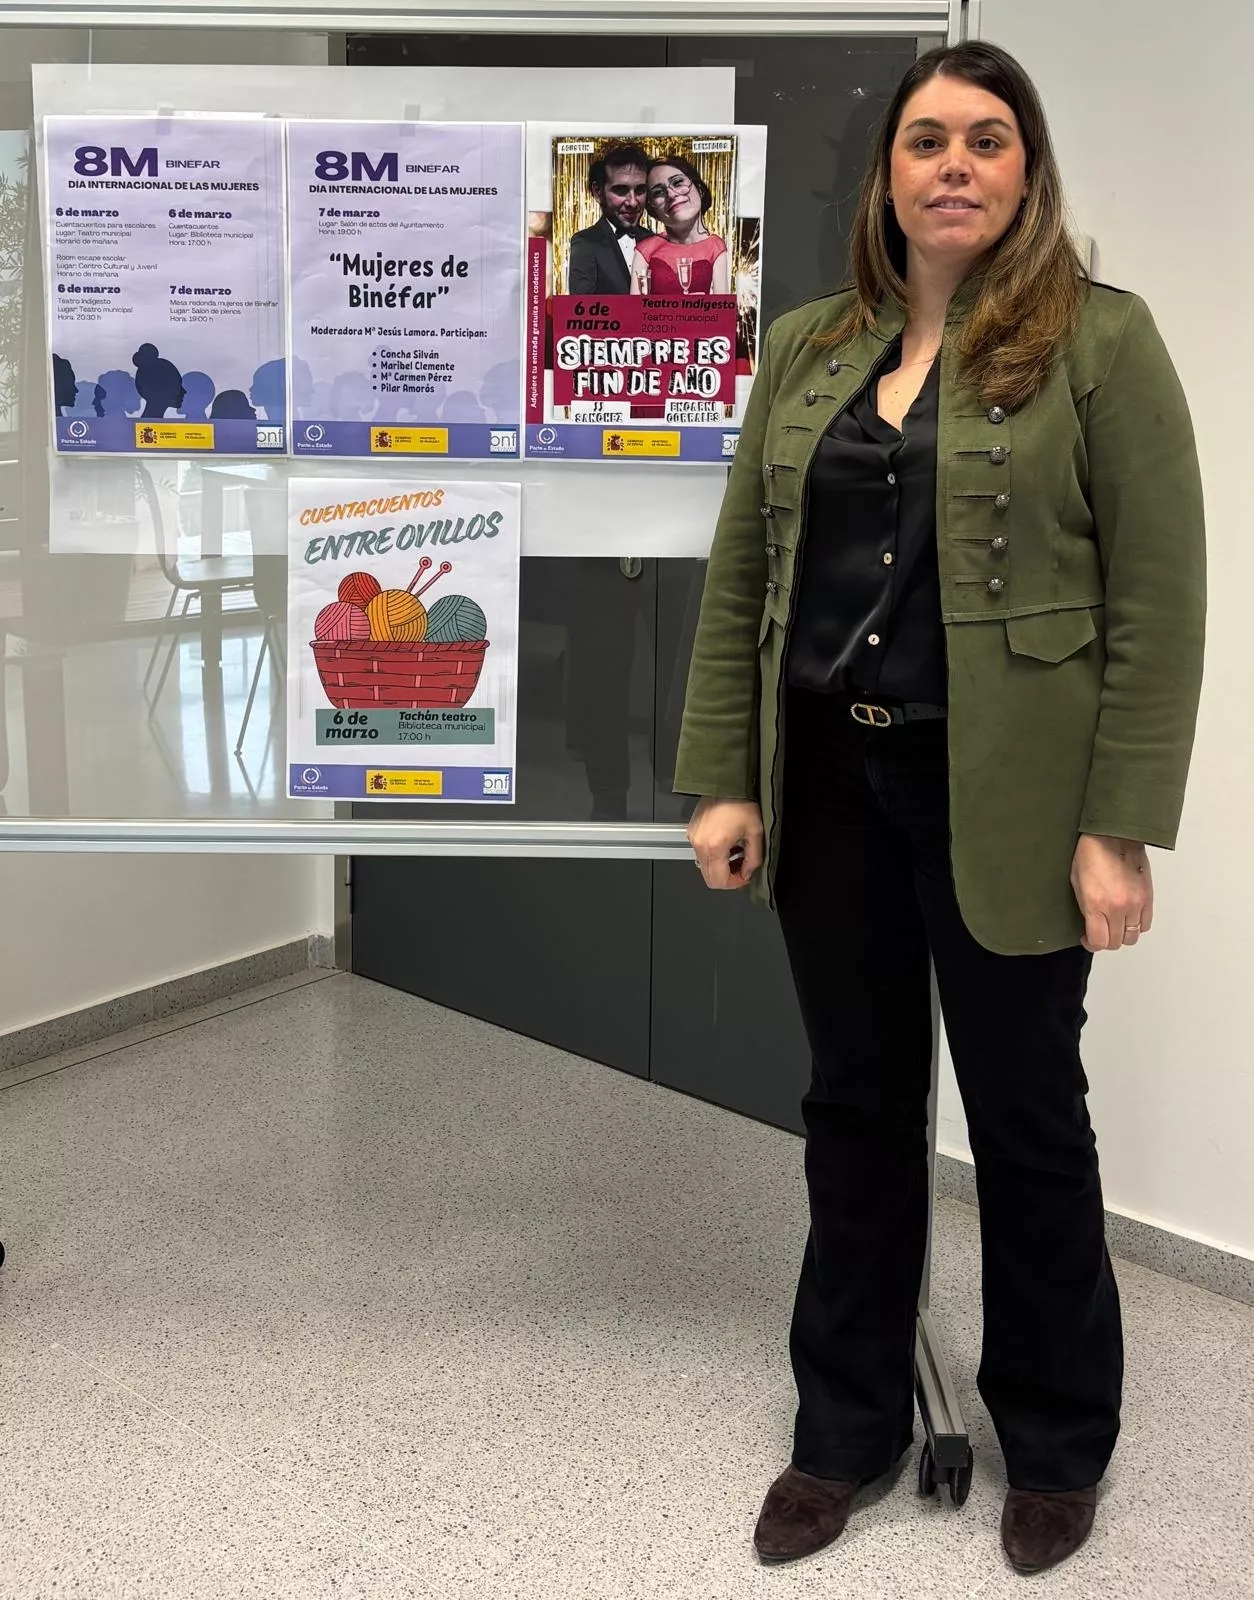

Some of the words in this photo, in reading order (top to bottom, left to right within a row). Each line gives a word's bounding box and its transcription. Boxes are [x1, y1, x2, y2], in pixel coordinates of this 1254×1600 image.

[74, 146, 158, 177] 8M
[166, 158, 220, 169] BINÉFAR
[315, 150, 398, 182] 8M
[405, 163, 460, 174] BINÉFAR
[88, 180, 173, 190] INTERNACIONAL
[175, 182, 188, 190] DE
[189, 182, 209, 190] LAS
[211, 182, 259, 191] MUJERES
[329, 185, 412, 195] INTERNACIONAL
[414, 186, 427, 195] DE
[429, 187, 448, 195] LAS
[450, 187, 498, 196] MUJERES
[56, 207, 63, 216] 6
[65, 207, 79, 216] de
[81, 209, 119, 217] marzo
[169, 209, 176, 218] 6
[178, 209, 192, 218] de
[194, 211, 232, 219] marzo
[318, 208, 325, 217] 7
[327, 208, 341, 217] de
[343, 210, 380, 218] marzo
[440, 254, 469, 278] de
[58, 284, 65, 293] 6
[67, 284, 81, 293] de
[83, 285, 121, 294] marzo
[169, 285, 177, 294] 7
[178, 285, 193, 295] de
[194, 287, 232, 295] marzo
[533, 294, 538, 304] en
[574, 301, 584, 316] 6
[589, 301, 610, 316] de
[641, 298, 678, 309] Teatro
[681, 298, 736, 312] Indigesto
[641, 312, 674, 322] Teatro
[675, 313, 718, 323] municipal
[566, 317, 621, 331] marzo
[641, 324, 670, 333] 20:30
[671, 325, 677, 333] h
[310, 326, 363, 336] Moderadora
[377, 327, 401, 337] Jesús
[403, 327, 438, 337] Lamora.
[440, 328, 488, 339] Participan:
[380, 350, 411, 359] Concha
[413, 350, 440, 359] Silván
[558, 336, 689, 368] SIEMPRE
[693, 337, 731, 366] ES
[380, 361, 413, 370] Maribel
[414, 362, 455, 371] Clemente
[531, 366, 537, 374] tu
[393, 373, 427, 382] Carmen
[428, 372, 453, 383] Pérez
[573, 368, 624, 396] FIN
[627, 369, 662, 396] DE
[668, 365, 721, 398] AÑO
[380, 383, 400, 393] Pilar
[402, 384, 435, 393] Amorós
[530, 375, 538, 409] Adquiere
[670, 402, 717, 412] ENCARNI
[666, 412, 720, 423] CORRALES
[300, 488, 445, 526] CUENTACUENTOS
[304, 527, 395, 564] ENTRE
[395, 511, 504, 551] OVILLOS
[333, 711, 343, 725] 6
[347, 711, 368, 725] de
[399, 710, 439, 722] Tachán
[441, 711, 477, 722] teatro
[398, 721, 442, 730] Biblioteca
[444, 722, 486, 732] municipal
[325, 727, 379, 739] marzo
[398, 732, 423, 741] 17:00
[425, 732, 431, 741] h
